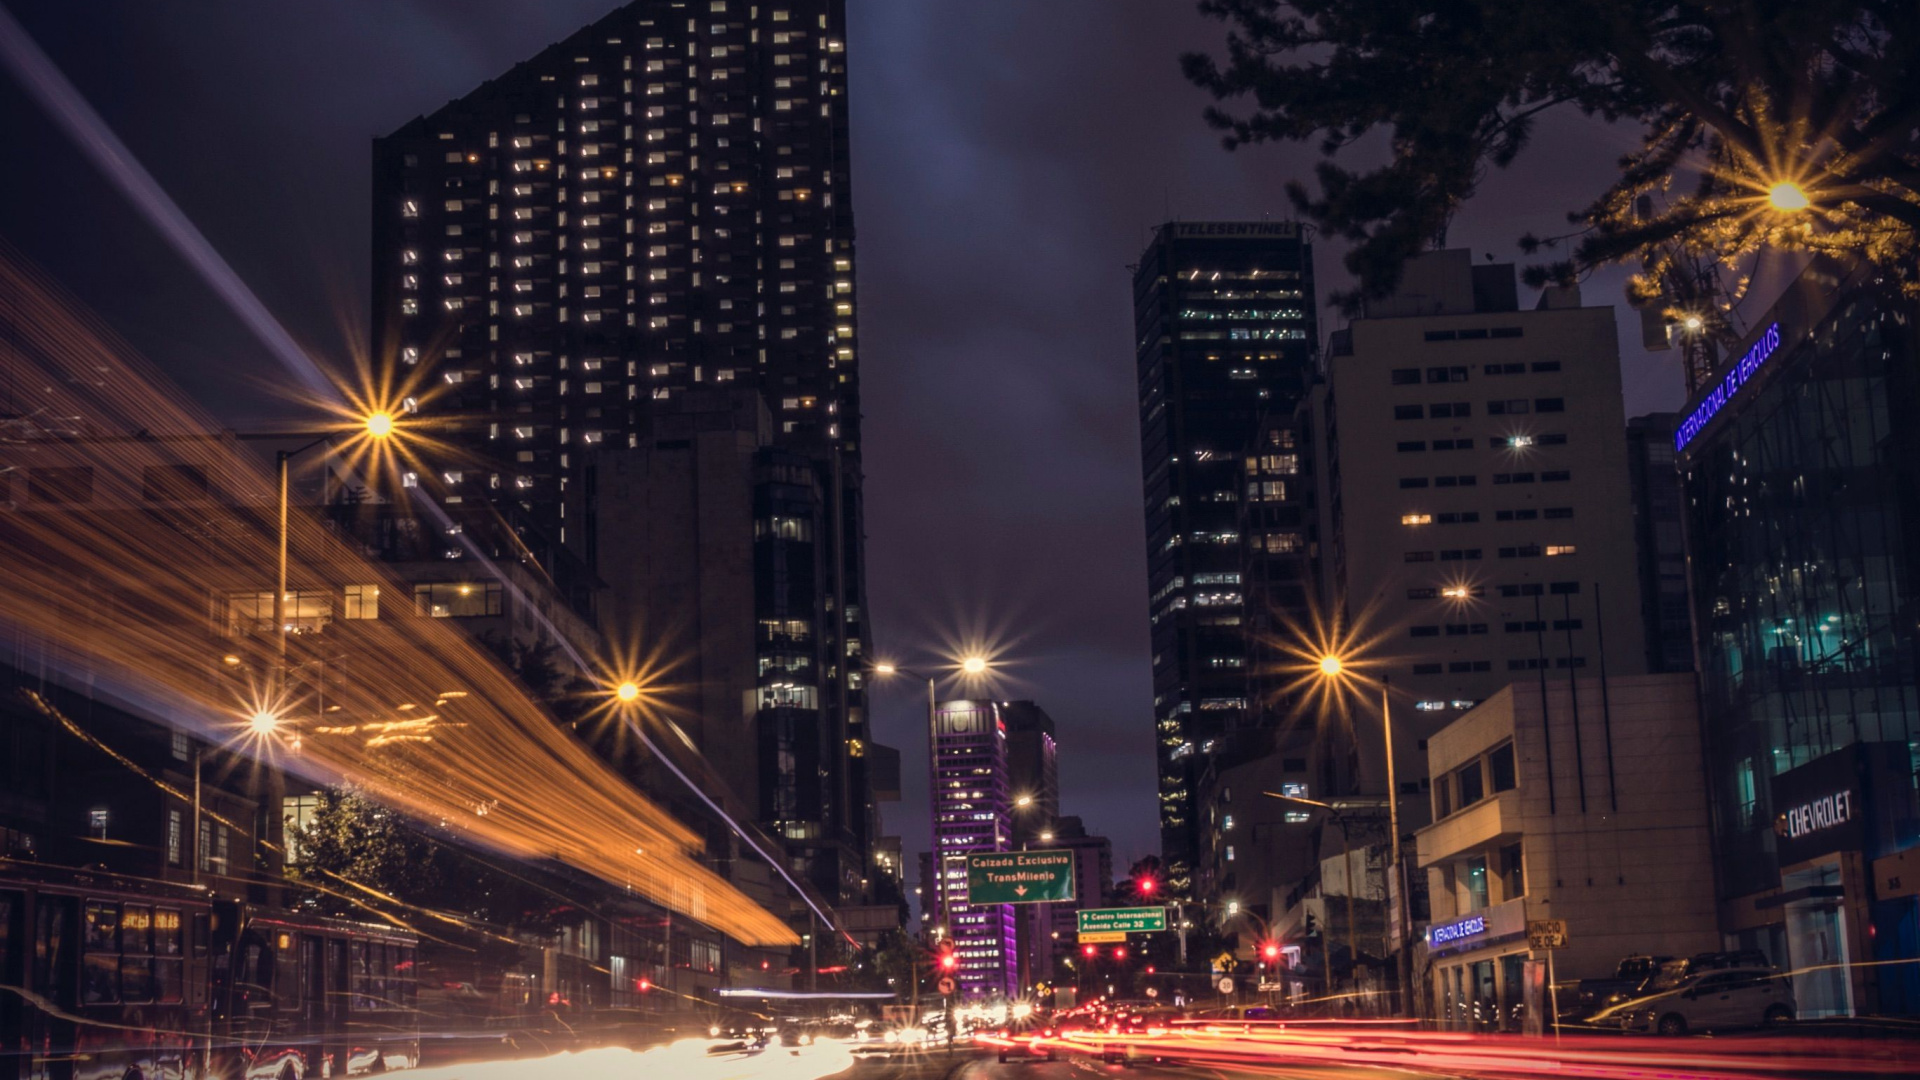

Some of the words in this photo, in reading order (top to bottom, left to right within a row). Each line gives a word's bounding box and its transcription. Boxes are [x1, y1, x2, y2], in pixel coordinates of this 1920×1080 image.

[1179, 222, 1293, 235] TELESENTINEL
[1675, 383, 1727, 452] INTERNACIONAL
[1726, 369, 1738, 398] DE
[1736, 322, 1780, 386] VEHICULOS
[1788, 790, 1851, 838] CHEVROLET
[972, 857, 1014, 868] Calzada
[1017, 855, 1069, 866] Exclusiva
[987, 871, 1055, 883] TransMilenio
[1091, 913, 1115, 921] Centro
[1116, 911, 1162, 920] Internacional
[1083, 922, 1112, 930] Avenida
[1113, 921, 1131, 929] Calle
[1133, 920, 1144, 928] 32
[1534, 921, 1561, 935] INICIO
[1531, 935, 1543, 948] DE
[1544, 934, 1567, 948] OBA
